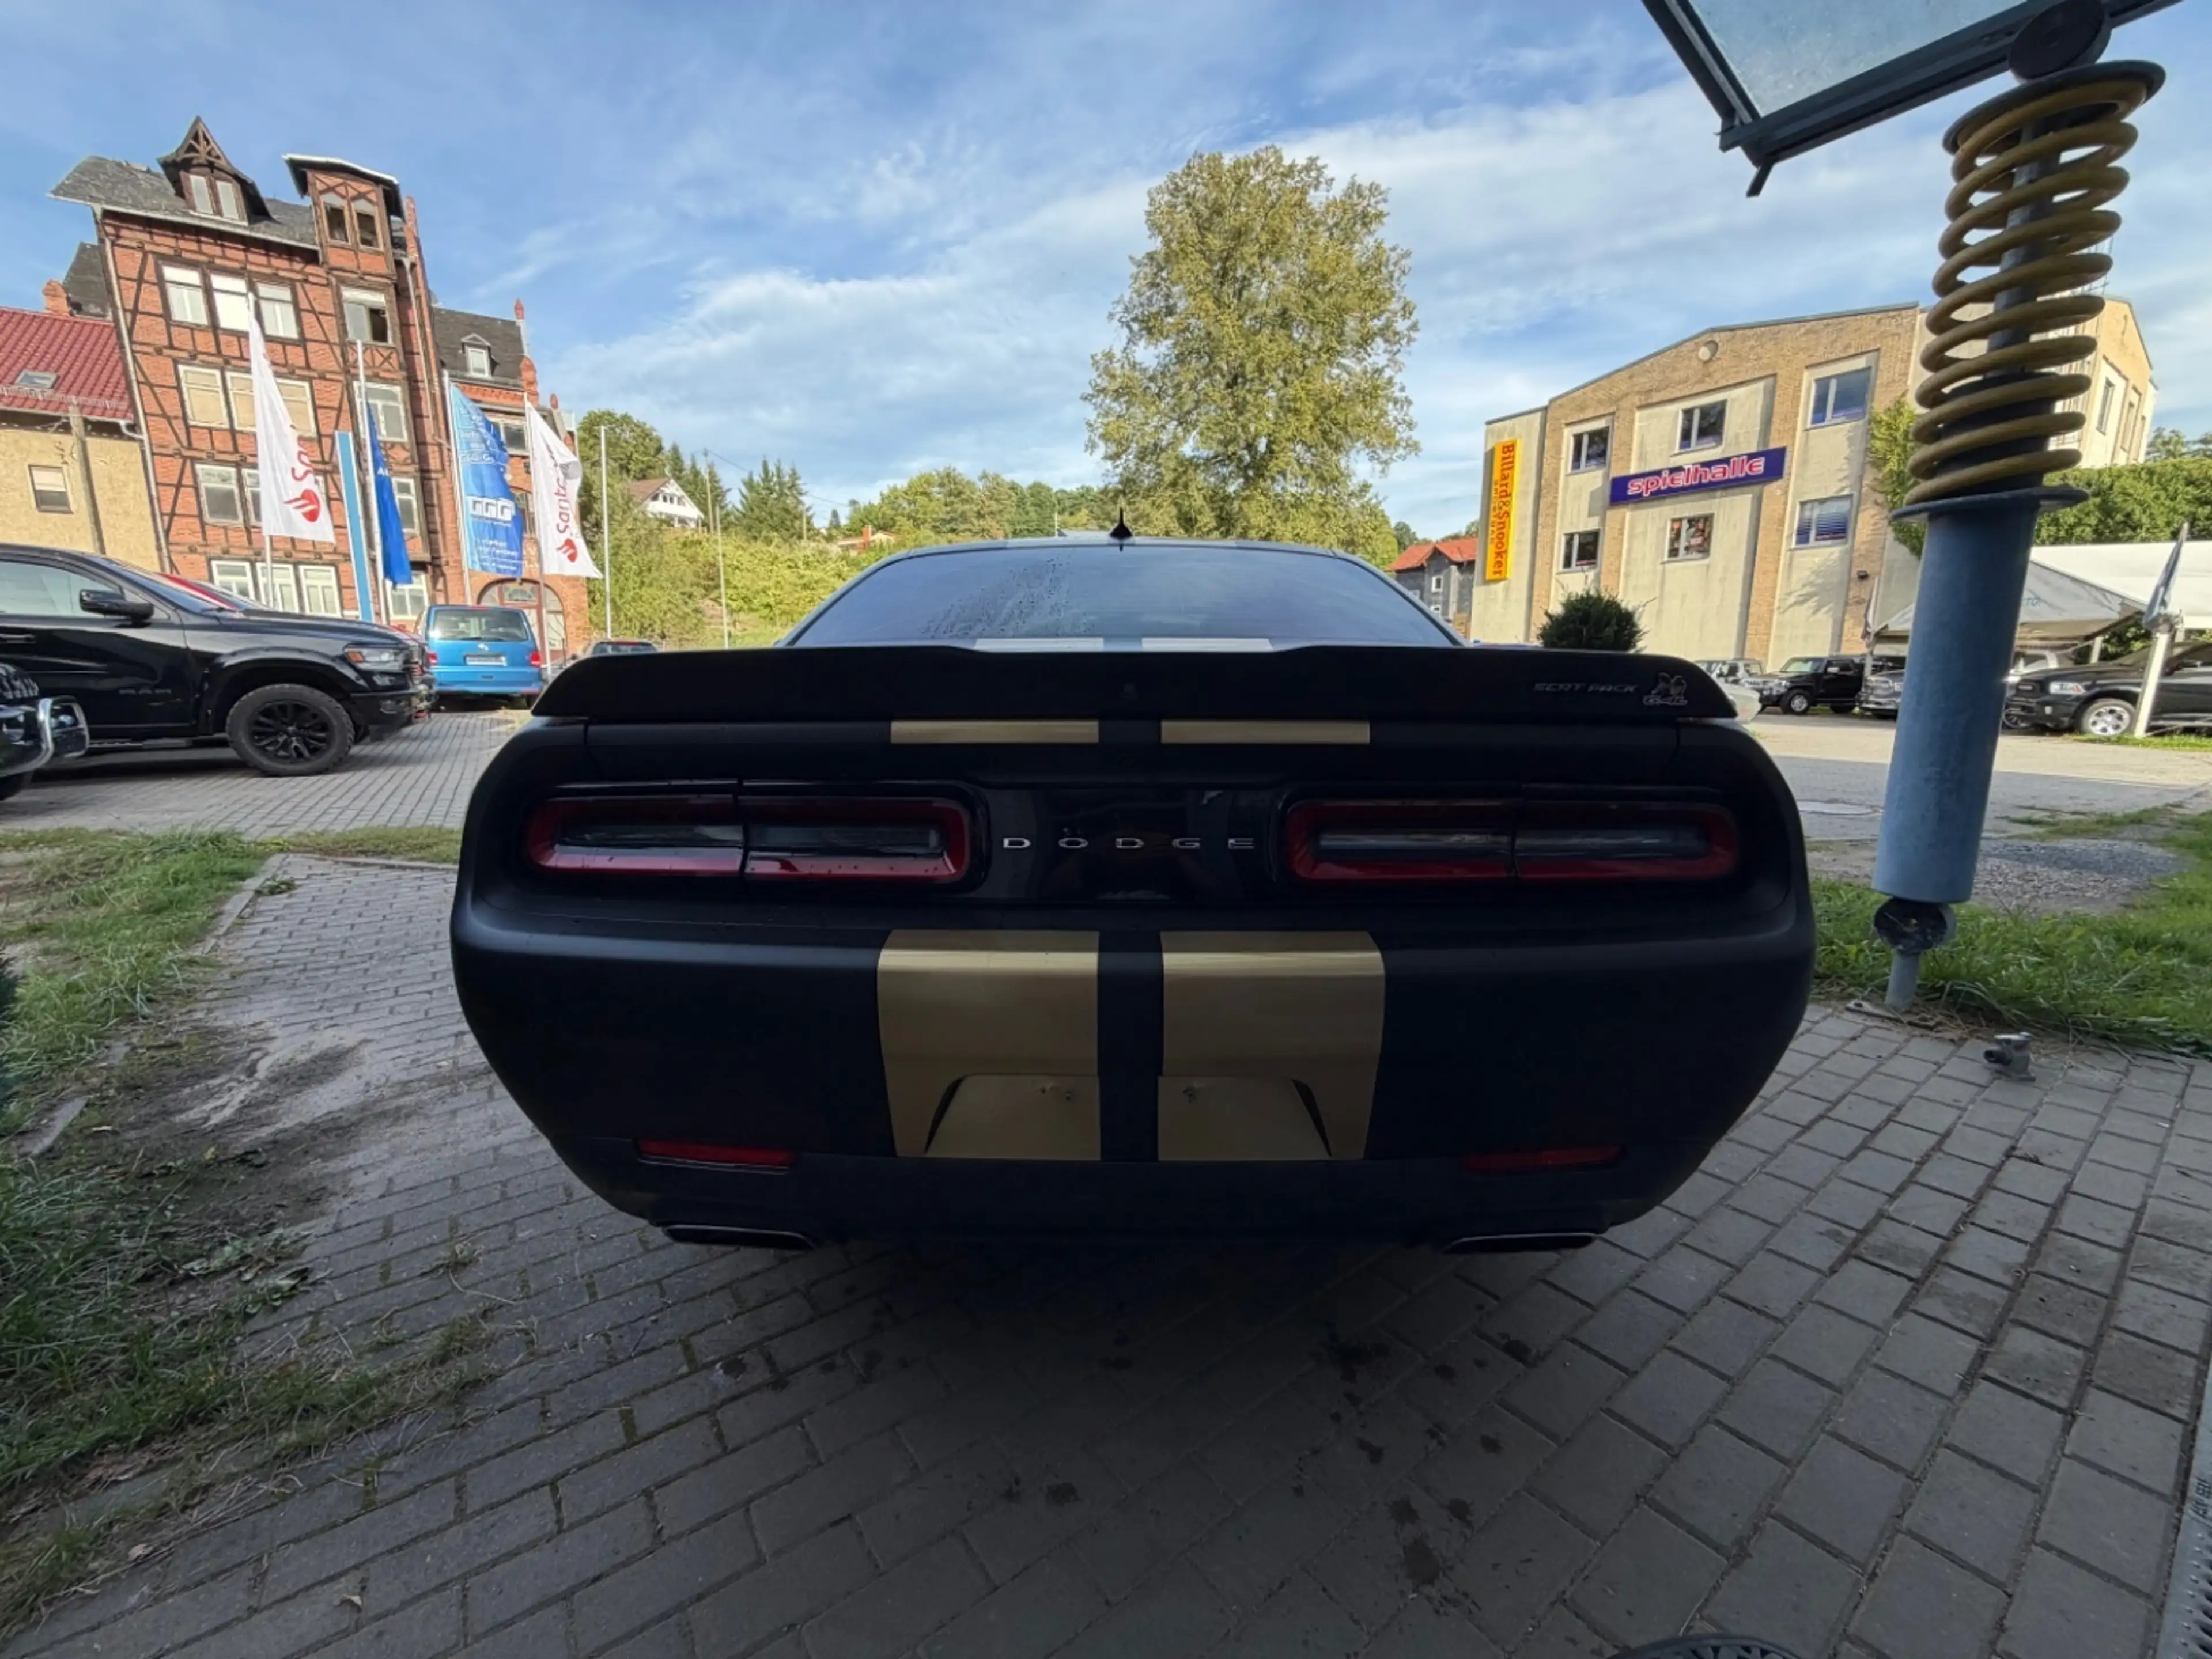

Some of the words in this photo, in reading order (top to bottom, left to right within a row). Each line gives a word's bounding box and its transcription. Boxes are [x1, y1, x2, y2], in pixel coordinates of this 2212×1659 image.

[1627, 456, 1765, 497] spielhalle
[1587, 683, 1640, 693] PACK
[1002, 837, 1254, 849] DODGE
